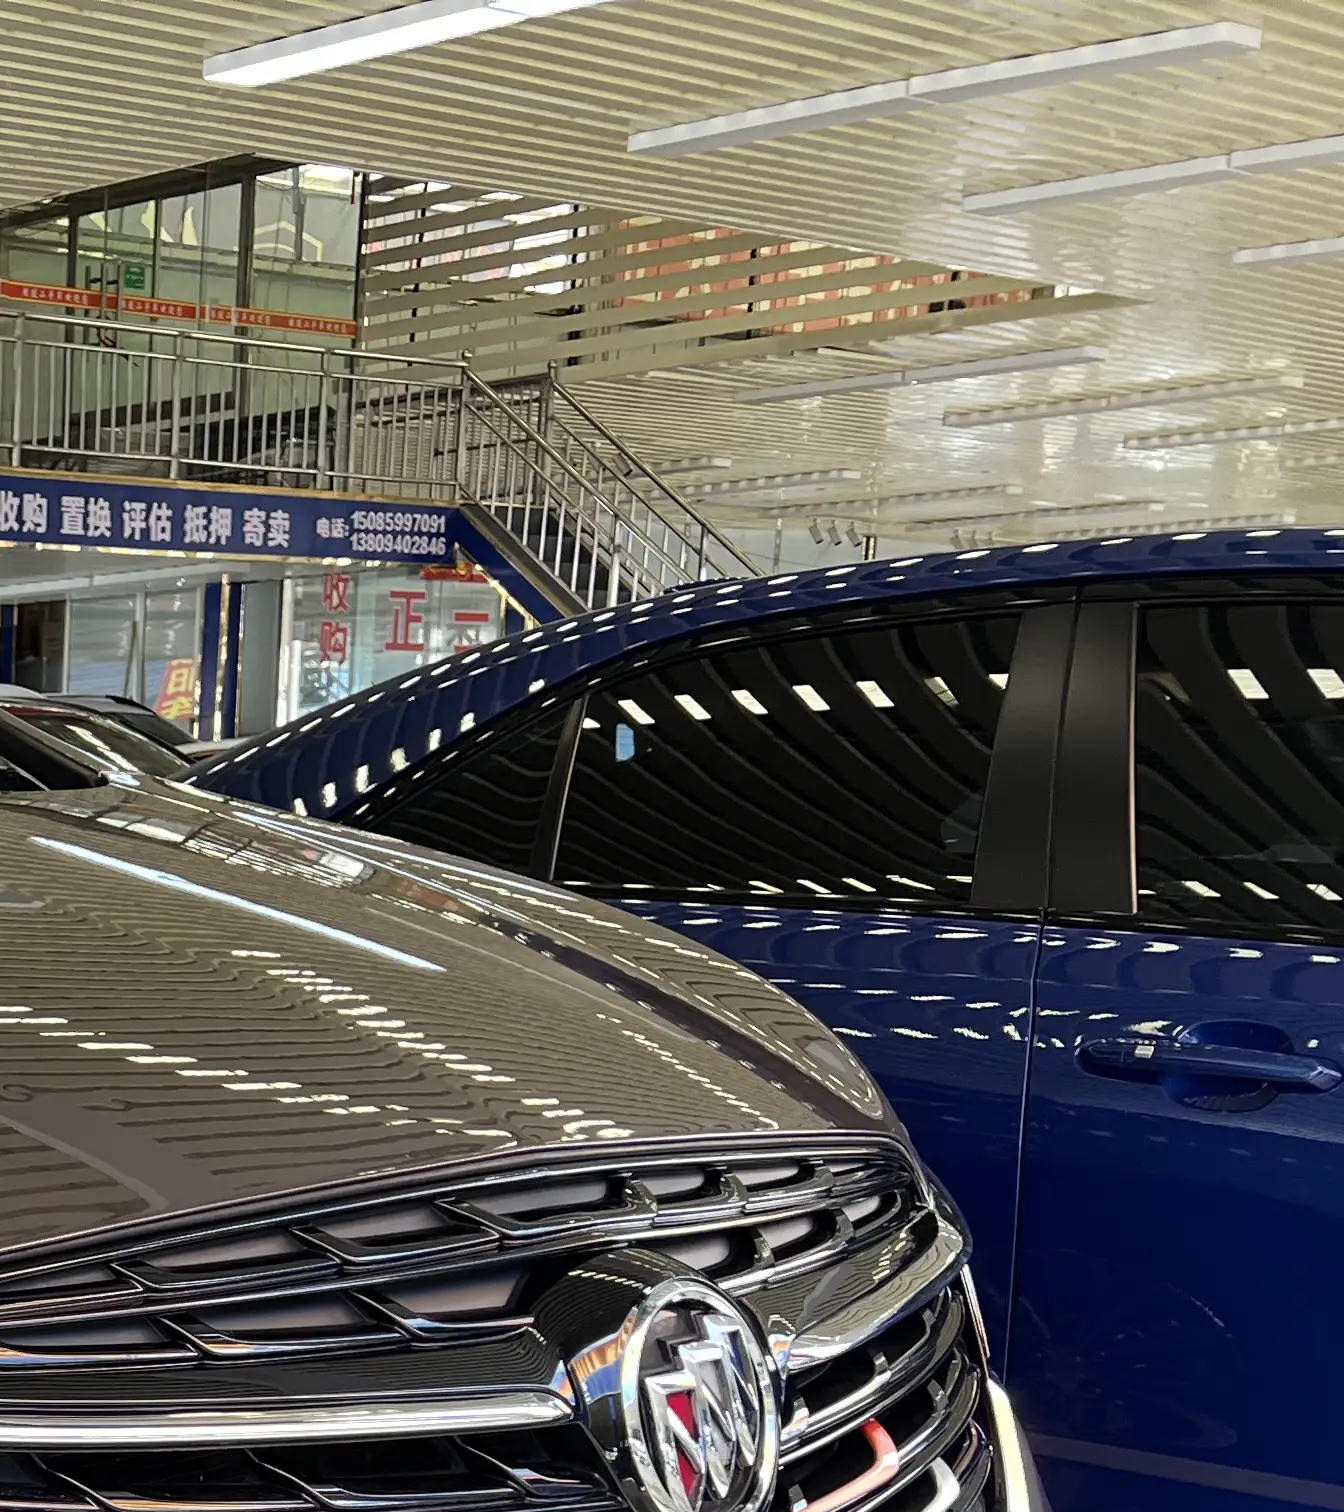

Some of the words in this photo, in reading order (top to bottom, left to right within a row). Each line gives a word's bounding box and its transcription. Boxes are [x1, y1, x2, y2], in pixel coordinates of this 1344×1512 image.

[60, 495, 112, 538] 置换
[122, 500, 173, 543] 评估
[183, 504, 233, 546] 抵押
[242, 508, 292, 549] 寄卖
[316, 516, 349, 539] 电话:
[350, 510, 446, 534] 15085997091
[350, 532, 447, 556] 13809402846
[384, 590, 427, 653] 正
